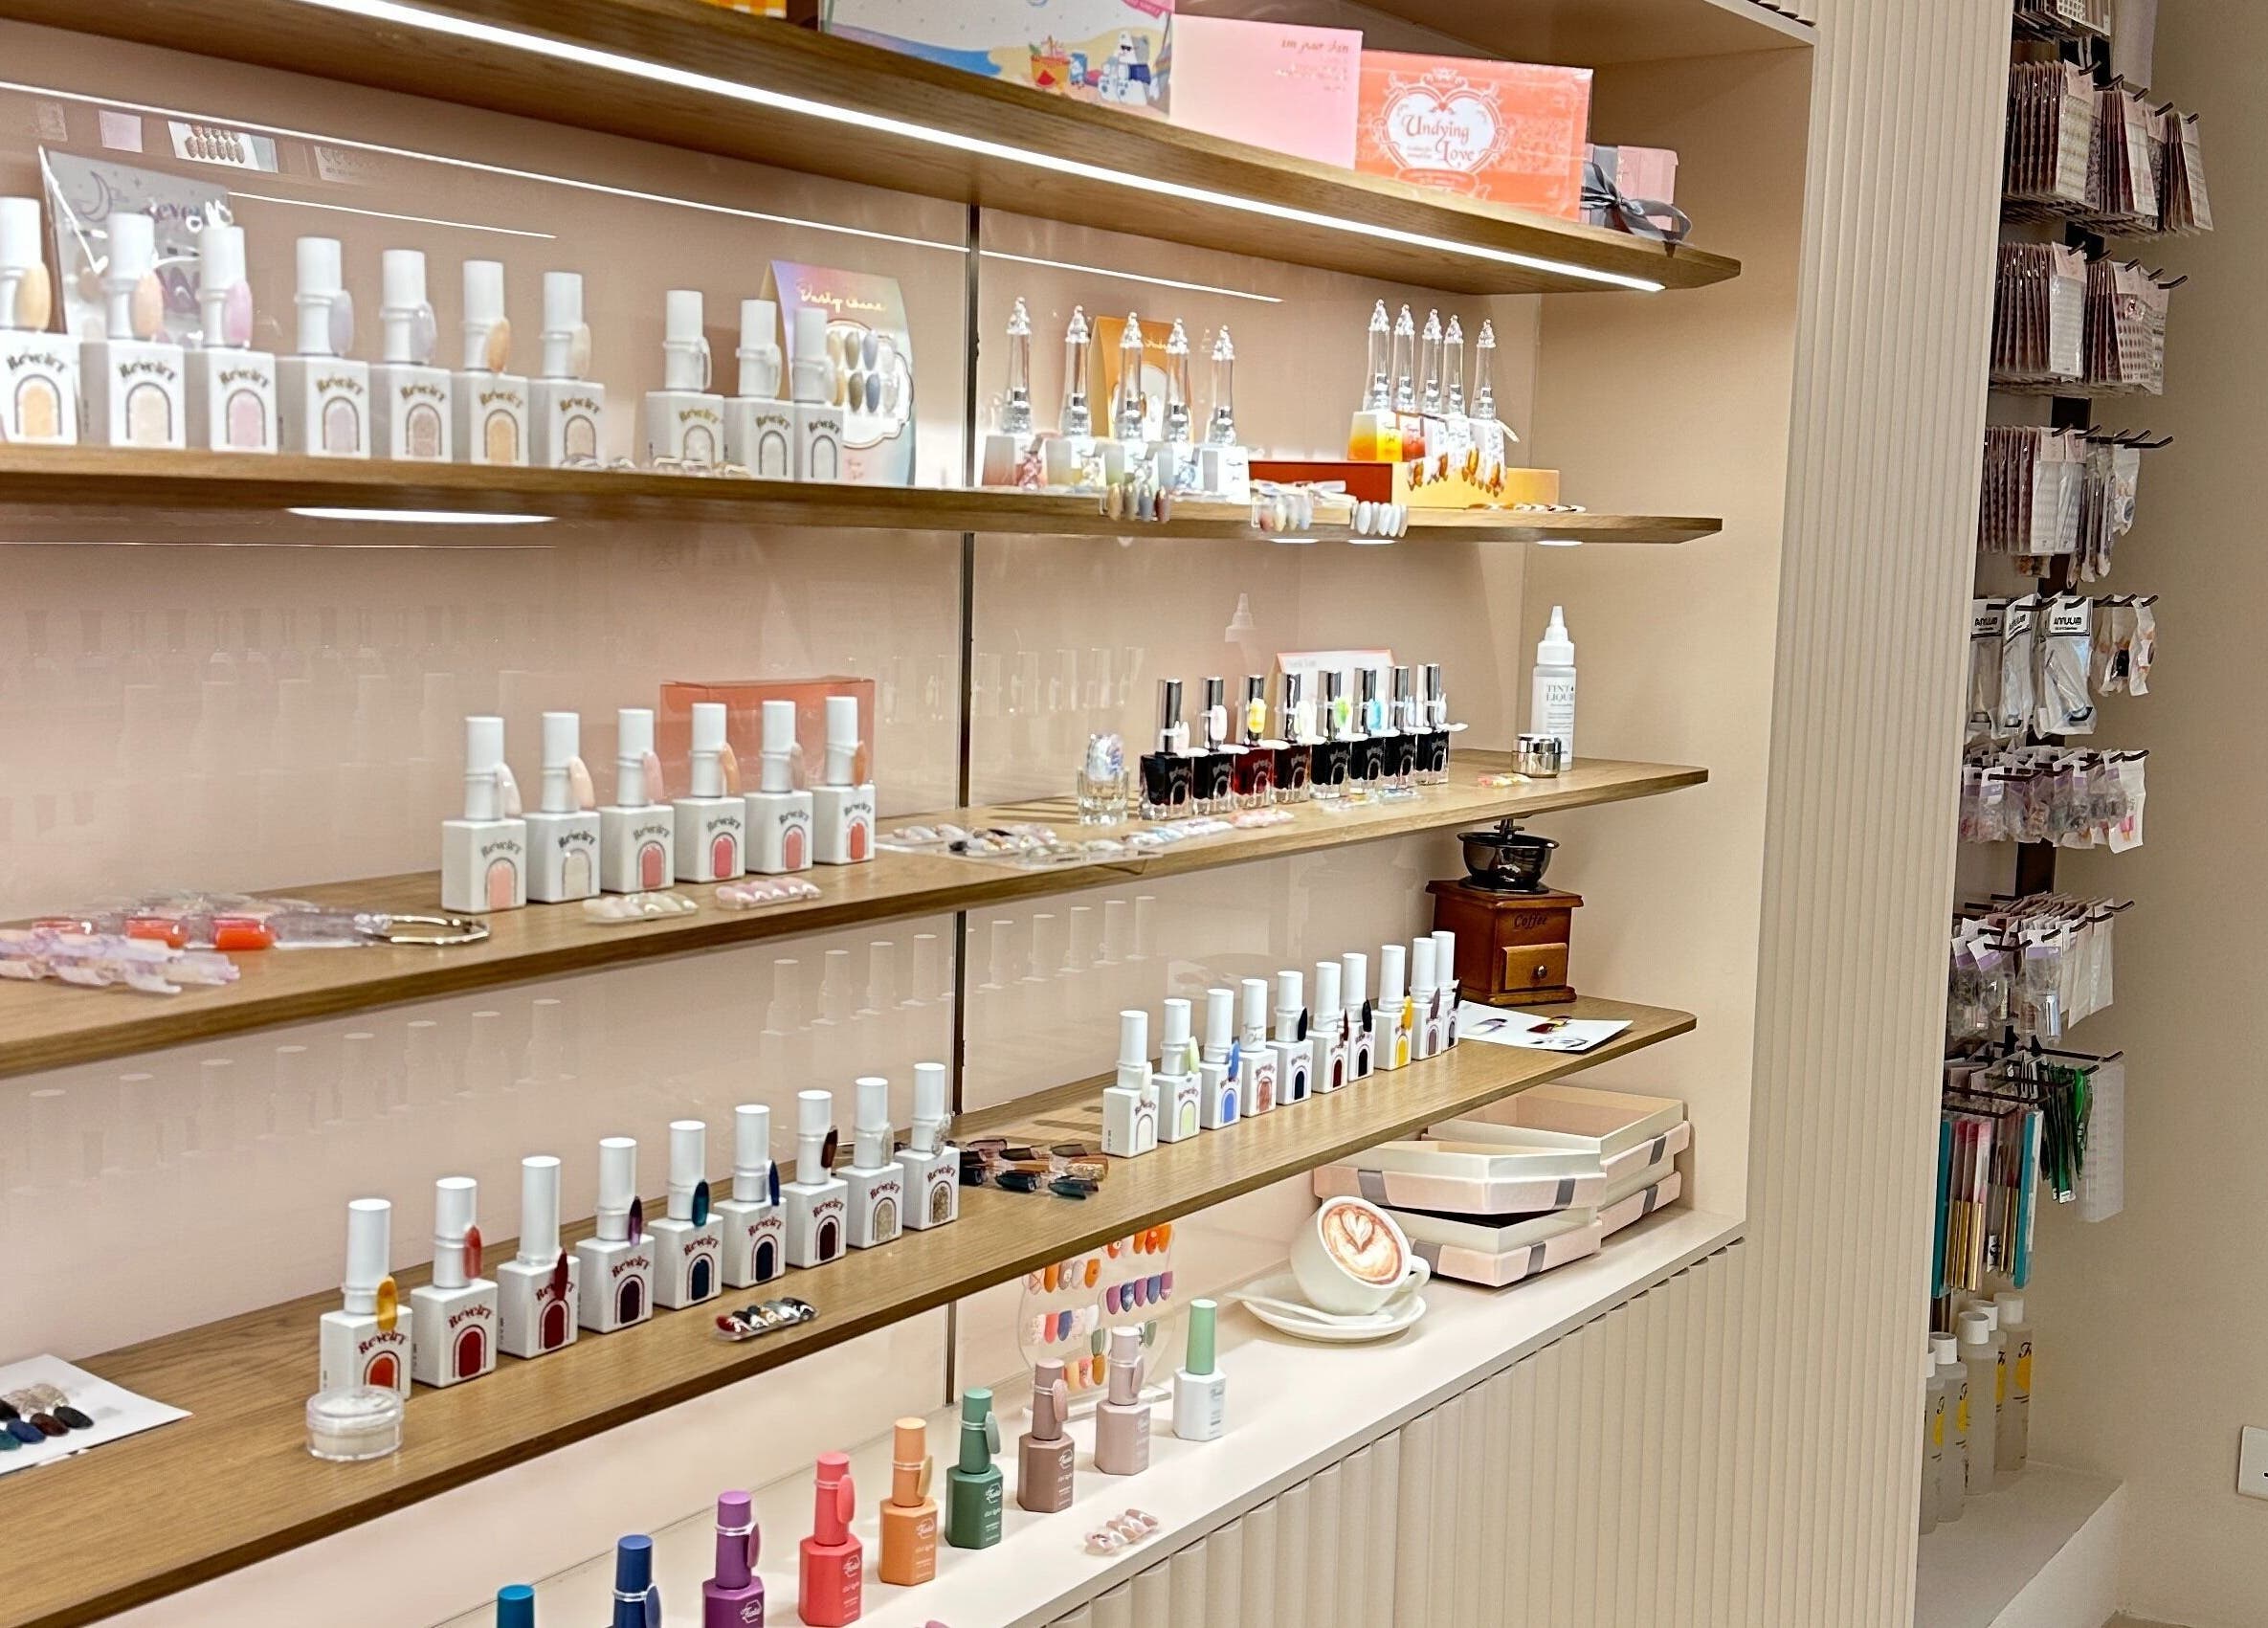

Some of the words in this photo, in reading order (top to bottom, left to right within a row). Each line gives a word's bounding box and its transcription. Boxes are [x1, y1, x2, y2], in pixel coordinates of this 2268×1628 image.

[1402, 115, 1470, 146] Undying
[1514, 912, 1547, 929] Coffee
[611, 1256, 651, 1278] Revelry
[449, 1305, 493, 1328] Revelry
[358, 1330, 407, 1355] Revelry
